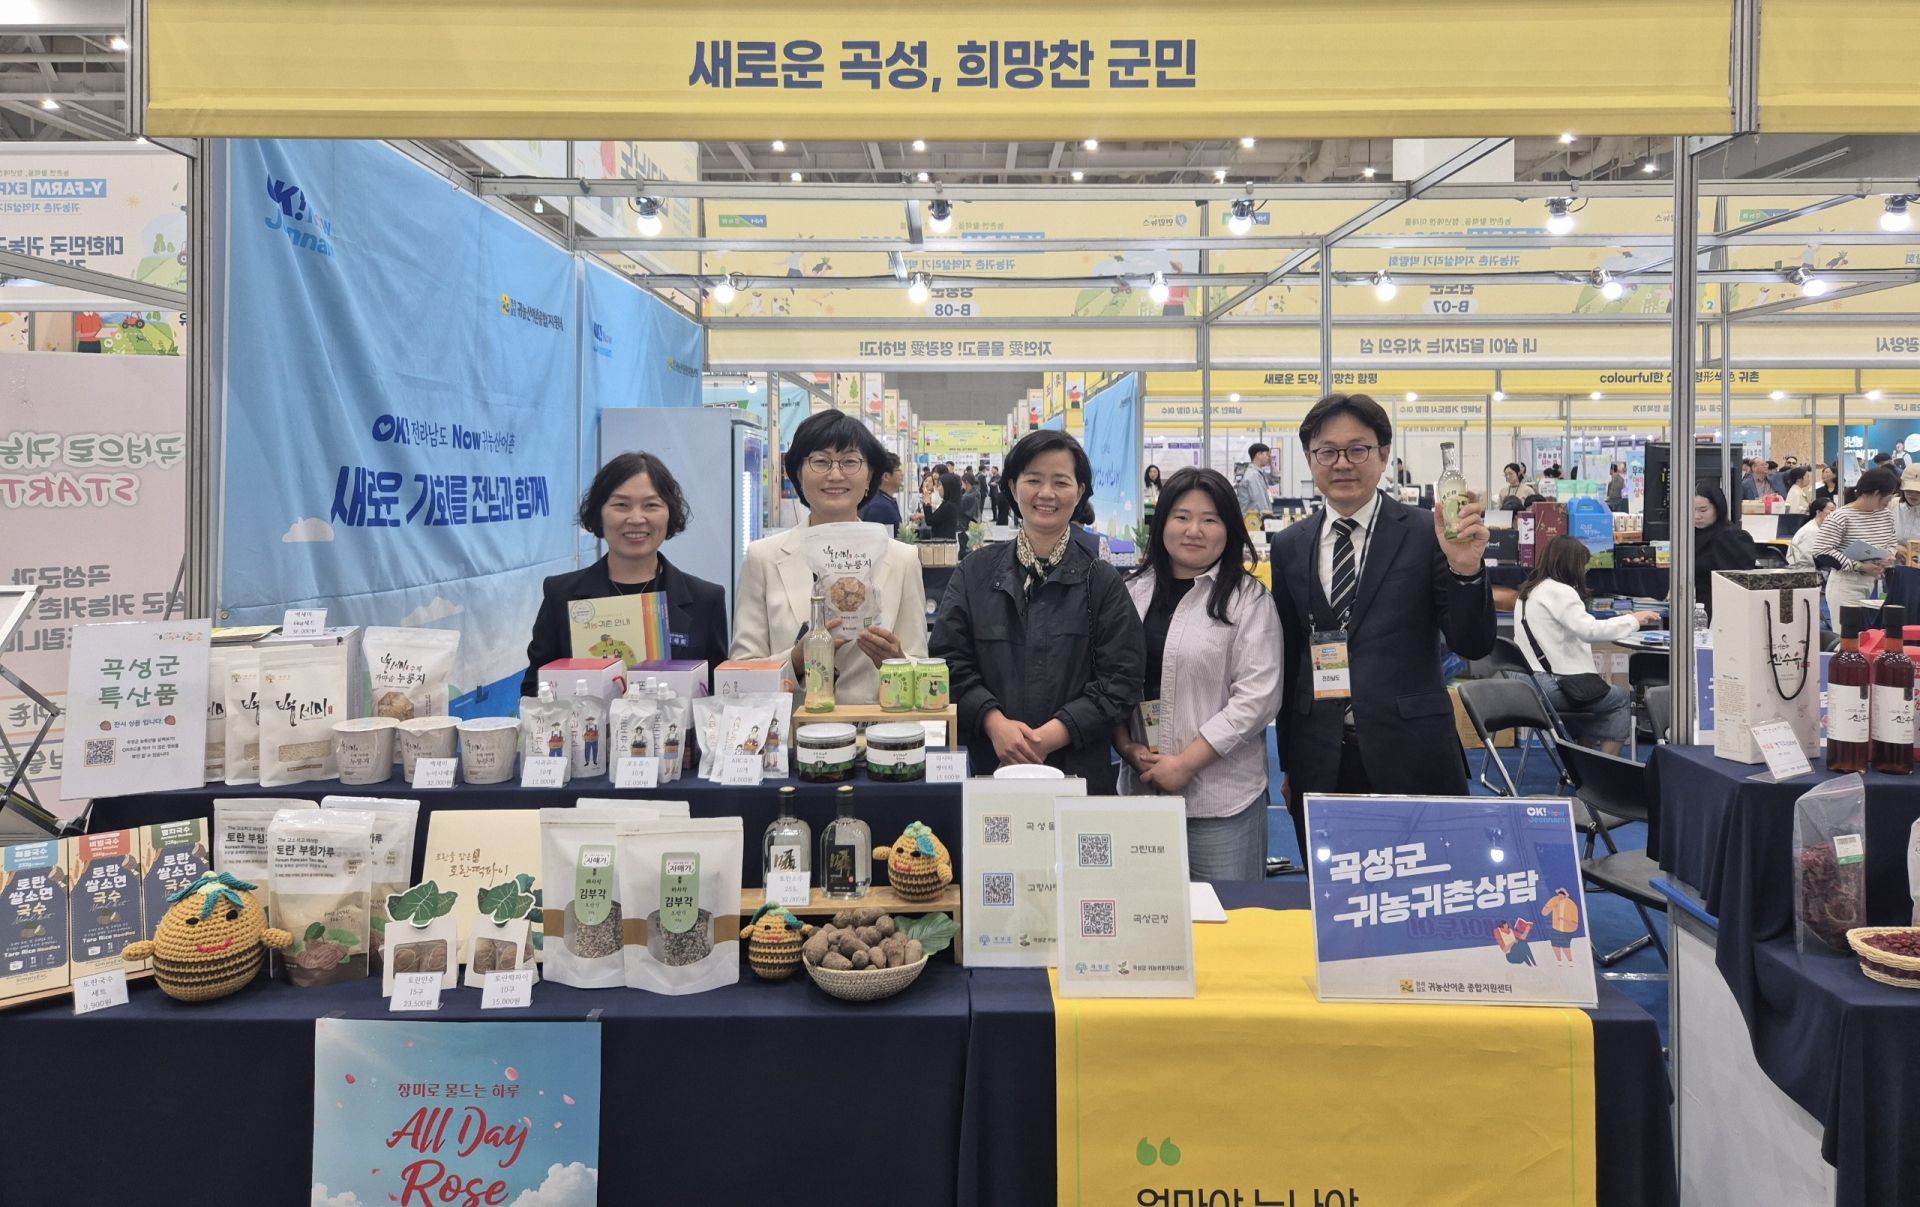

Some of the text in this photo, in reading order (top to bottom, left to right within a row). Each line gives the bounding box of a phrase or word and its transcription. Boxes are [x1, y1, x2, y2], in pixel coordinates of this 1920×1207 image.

[689, 39, 1196, 93] 새로운 곡성, 희망찬 군민
[1264, 373, 1378, 386] 새로운 도약, 망찬 함평
[1600, 371, 1760, 384] colourful한 귀촌
[372, 414, 410, 445] OK!
[411, 420, 448, 448] 전라남도
[453, 424, 481, 450] Now
[331, 465, 549, 527] 새로운 기회를 전남과 함께
[844, 559, 872, 569] 누룽지
[584, 618, 631, 630] 귀농귀촌 안내
[101, 655, 180, 680] 곡성군
[397, 673, 426, 684] 누룽지
[98, 683, 179, 710] 특산품
[1526, 807, 1547, 816] OK!
[161, 826, 191, 837] 멸치국수
[226, 832, 245, 843] 토란
[276, 845, 335, 857] 토란 부침가루
[1130, 844, 1166, 855] 그린대로
[163, 852, 190, 867] 토란
[1330, 842, 1452, 885] 곡성군
[92, 864, 120, 879] 토란
[157, 863, 197, 880] 쌀소면
[448, 862, 509, 888] 토란떡파이
[669, 864, 692, 873] 자매가
[17, 875, 47, 891] 토란
[85, 875, 127, 893] 쌀소면
[9, 887, 53, 905] 쌀소면
[93, 890, 121, 904] 국수
[580, 888, 607, 900] 김부각
[1333, 870, 1539, 928] 귀농귀촌상담
[17, 902, 47, 917] 국수
[665, 896, 693, 908] 김부각
[98, 933, 112, 941] Rice
[1428, 982, 1513, 994] 귀농산어촌 종합지원센터
[399, 1082, 520, 1099] 장미로 물드는 하루
[386, 1106, 529, 1168] All Day
[400, 1158, 509, 1207] Rose
